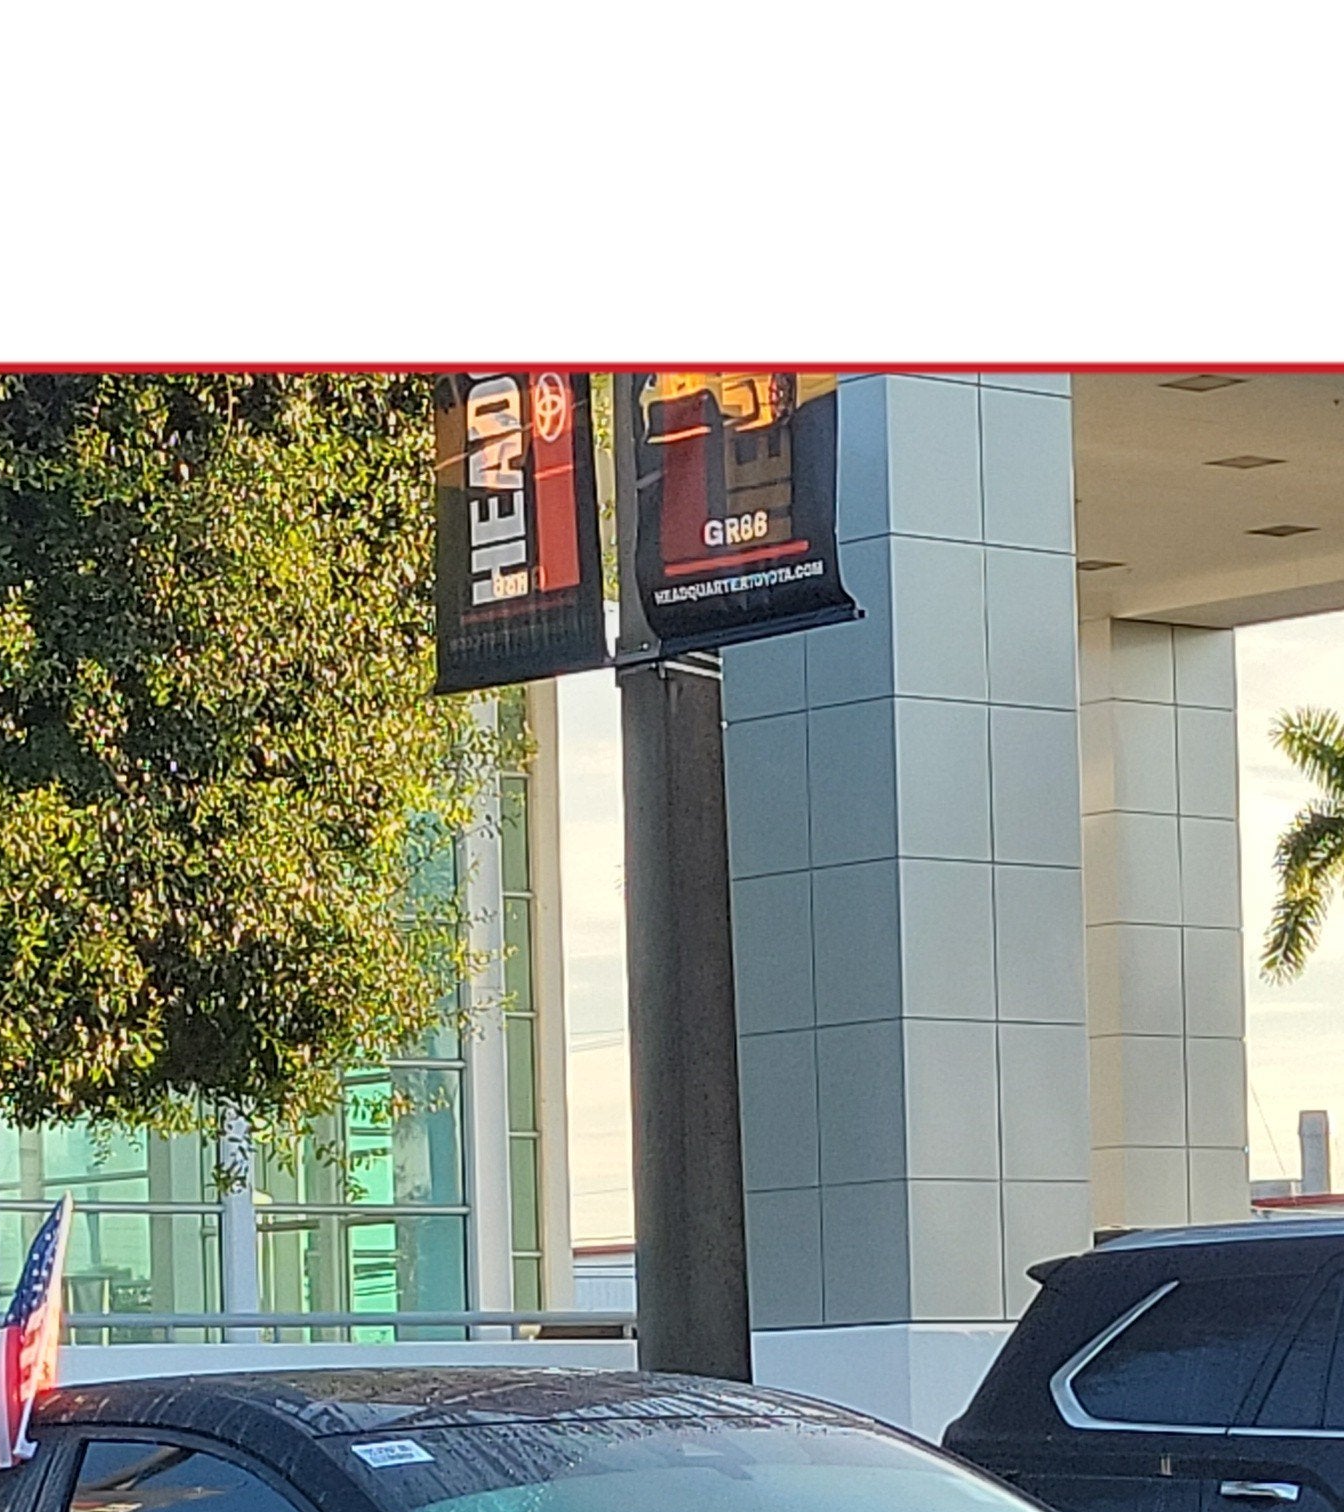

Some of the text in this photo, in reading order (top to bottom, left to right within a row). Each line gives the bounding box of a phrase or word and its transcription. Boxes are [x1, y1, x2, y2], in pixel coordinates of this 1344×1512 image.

[467, 373, 529, 607] HEAD
[703, 510, 769, 547] GR86
[653, 560, 825, 606] HEADQUARTERTOYOTA.COM
